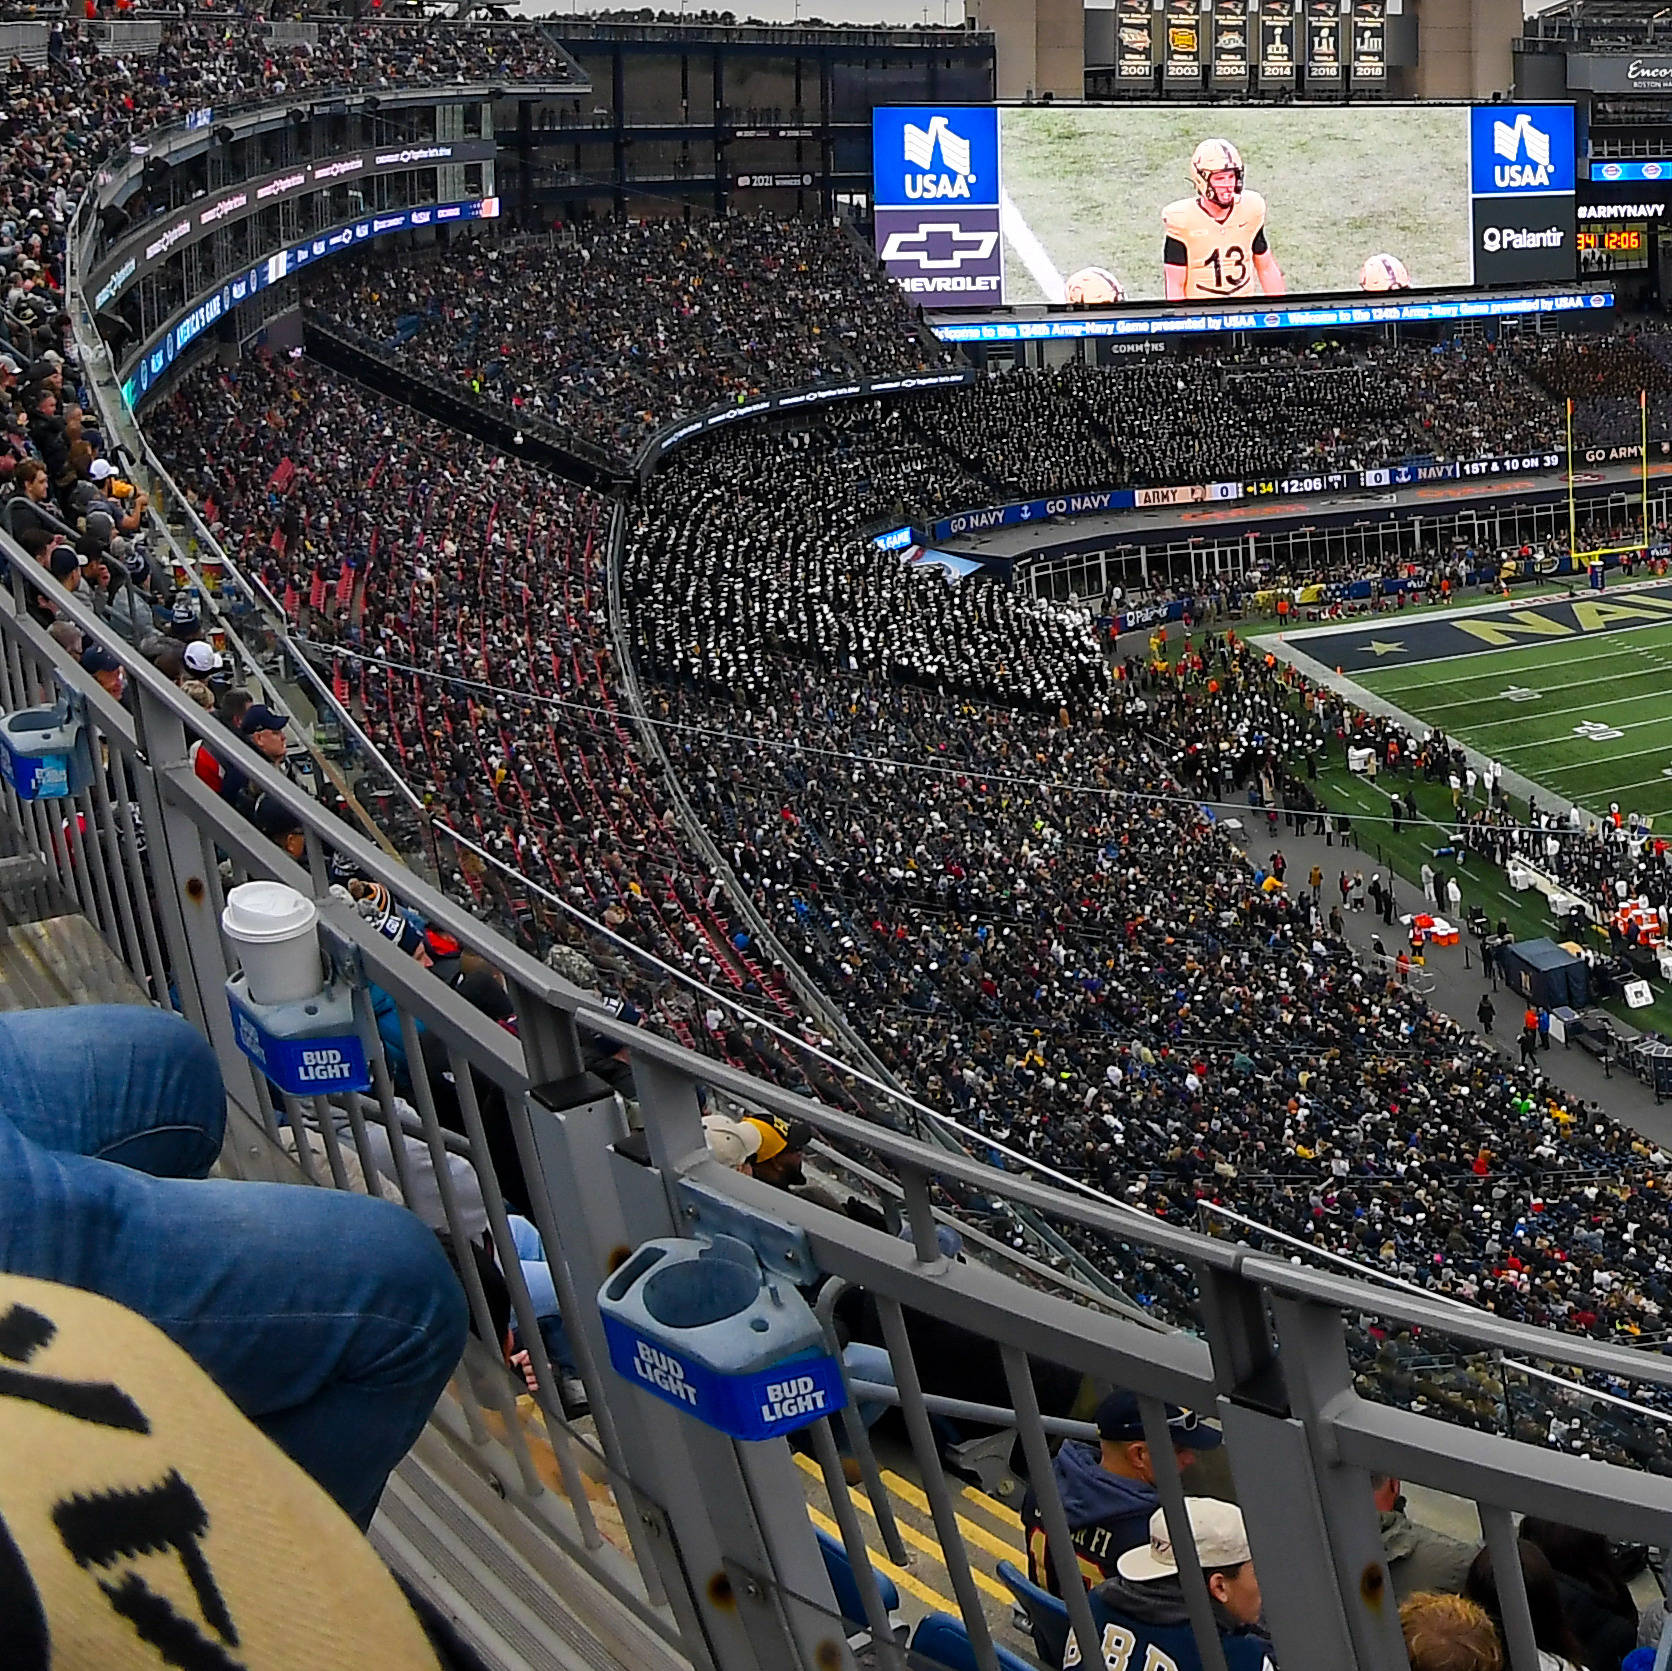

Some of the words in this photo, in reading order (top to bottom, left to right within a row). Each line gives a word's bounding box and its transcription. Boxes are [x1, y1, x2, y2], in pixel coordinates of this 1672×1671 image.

[1120, 66, 1150, 76] 2001
[1167, 66, 1198, 76] 2003
[1215, 66, 1246, 76] 2004
[1494, 165, 1550, 187] USAA
[904, 173, 971, 199] USAA
[1577, 204, 1665, 219] #ARMYNAVY
[1502, 227, 1564, 249] Palantir
[1604, 232, 1640, 250] 12:06
[1203, 245, 1246, 286] 13
[888, 276, 1000, 292] HEVROLET
[1224, 316, 1256, 328] USAA
[1464, 461, 1488, 475] 1ST
[1504, 459, 1519, 471] 10
[1523, 457, 1539, 469] ON
[1544, 454, 1559, 467] 39
[1586, 449, 1606, 462] GO
[1375, 472, 1383, 484] 0
[1418, 465, 1455, 479] NAVY
[1143, 489, 1178, 505] ARMY
[1220, 485, 1229, 498] 0
[1259, 482, 1273, 494] 34
[1281, 478, 1322, 493] 12:06
[1046, 498, 1067, 514] GO
[1071, 494, 1111, 512] NAVY
[951, 518, 966, 533] GO
[970, 509, 1005, 529] NAVY
[302, 1049, 341, 1066] BUD
[298, 1063, 351, 1081] LIGHT
[636, 1339, 684, 1380] BUD
[633, 1356, 697, 1406] LIGHT
[766, 1376, 814, 1403] BUD
[761, 1390, 825, 1422] LIGHT
